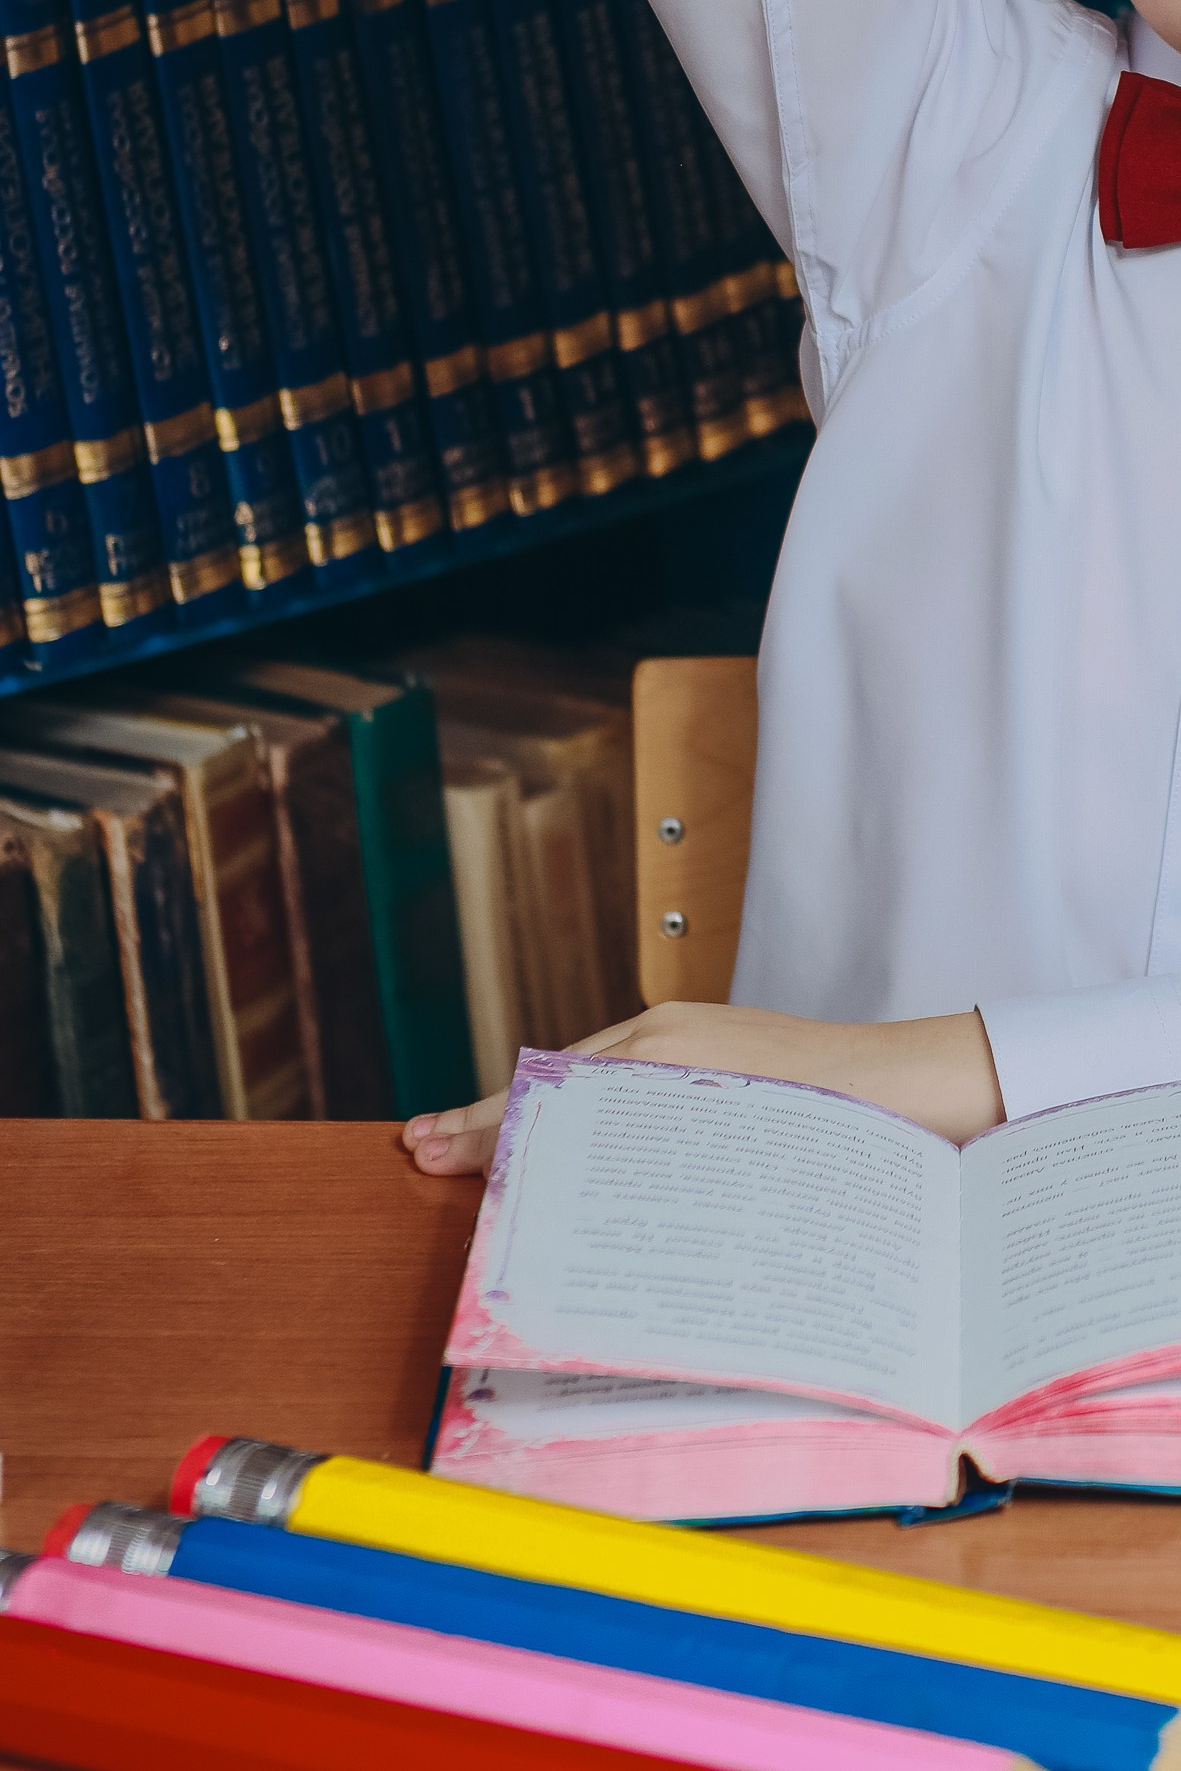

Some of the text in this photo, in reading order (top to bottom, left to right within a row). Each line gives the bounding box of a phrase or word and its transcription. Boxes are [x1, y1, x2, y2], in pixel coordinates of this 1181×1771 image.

[1120, 1117, 1165, 1129] Какая,
[1032, 1128, 1115, 1152] собственно,
[1096, 1135, 1127, 1144] есть.
[1001, 1155, 1048, 1173] прики-
[1052, 1148, 1114, 1167] ответила
[1075, 1167, 1119, 1182] прямо
[1139, 1164, 1179, 1176] видят
[1098, 1174, 1129, 1188] нас?
[1002, 1192, 1064, 1218] шепотом
